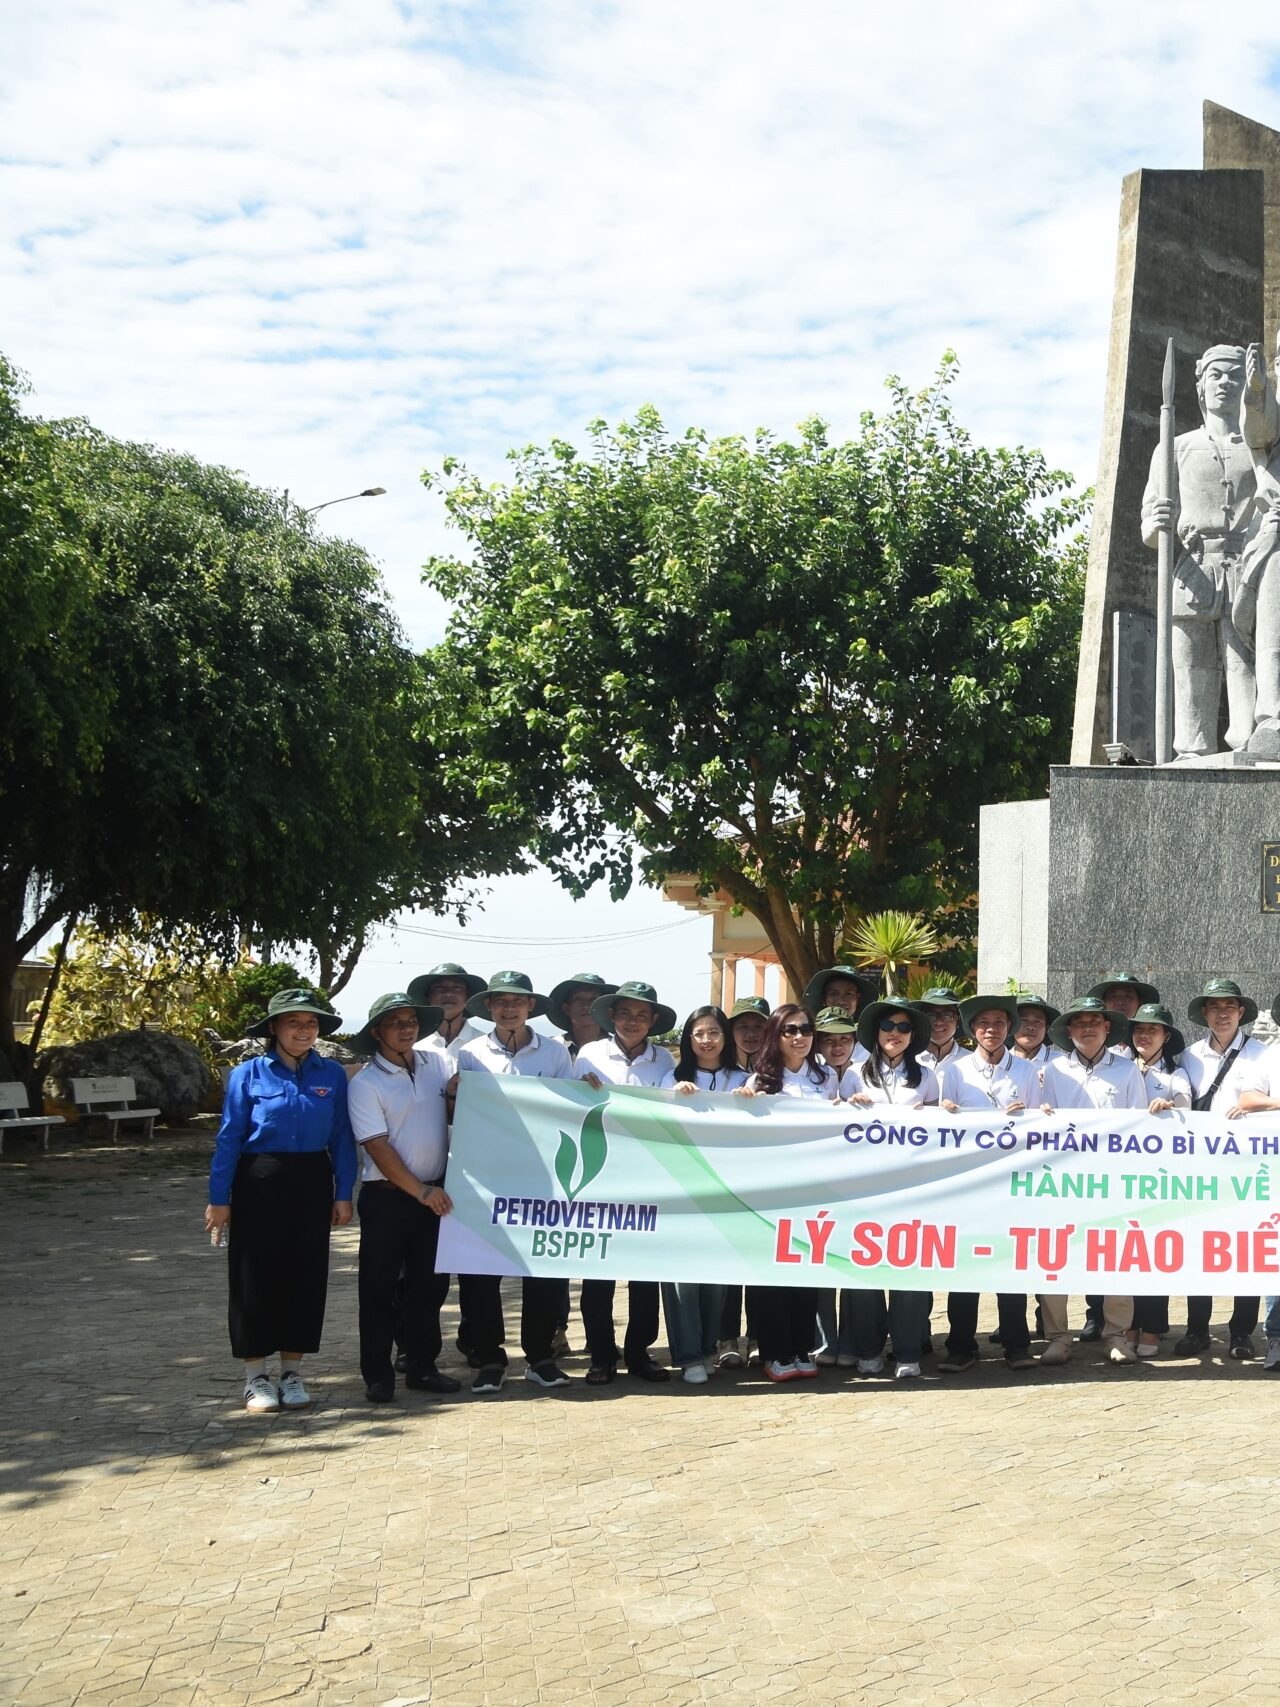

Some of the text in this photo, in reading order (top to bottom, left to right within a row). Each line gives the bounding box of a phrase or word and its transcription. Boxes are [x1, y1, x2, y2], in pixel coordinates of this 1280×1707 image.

[843, 1120, 929, 1147] CÔNG
[938, 1128, 966, 1148] TY
[975, 1121, 1017, 1150] CỔ
[1026, 1120, 1098, 1152] PHẦN
[1108, 1133, 1163, 1154] BAO
[1172, 1128, 1196, 1154] BÌ
[1203, 1130, 1240, 1155] VÀ
[1010, 1165, 1109, 1198] HÀNH
[1121, 1167, 1219, 1200] TRÌNH
[1231, 1163, 1271, 1201] VỀ
[492, 1197, 658, 1231] PETROVIETNAM
[532, 1229, 612, 1260] BSPPT
[775, 1211, 836, 1264] LÝ
[851, 1219, 957, 1269] SƠN
[974, 1246, 992, 1256] -
[1009, 1223, 1075, 1281] TỰ
[1086, 1220, 1184, 1273] HÀO
